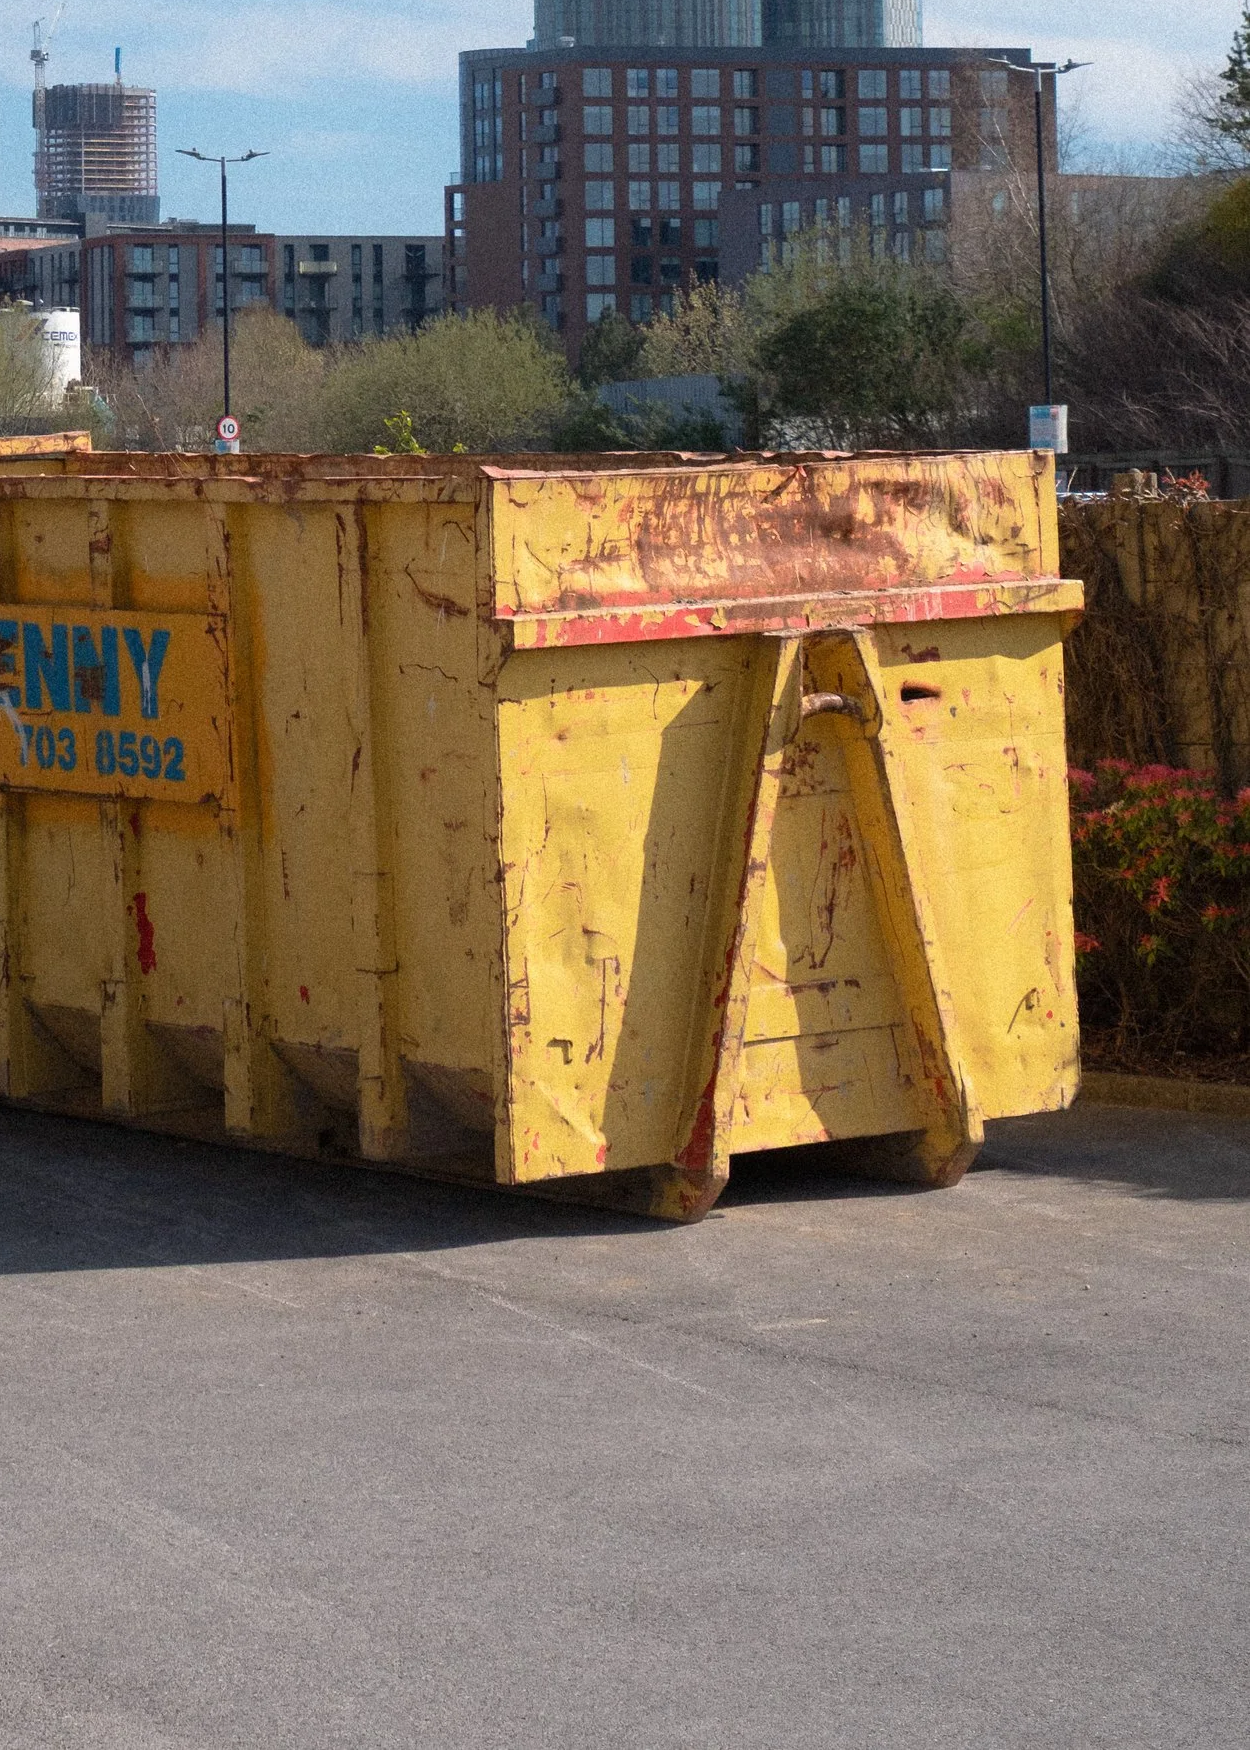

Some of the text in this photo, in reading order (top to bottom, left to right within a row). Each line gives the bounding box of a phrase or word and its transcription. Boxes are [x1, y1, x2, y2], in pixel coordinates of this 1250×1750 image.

[222, 423, 235, 434] 10
[16, 724, 78, 771] 703
[95, 729, 186, 782] 8592
